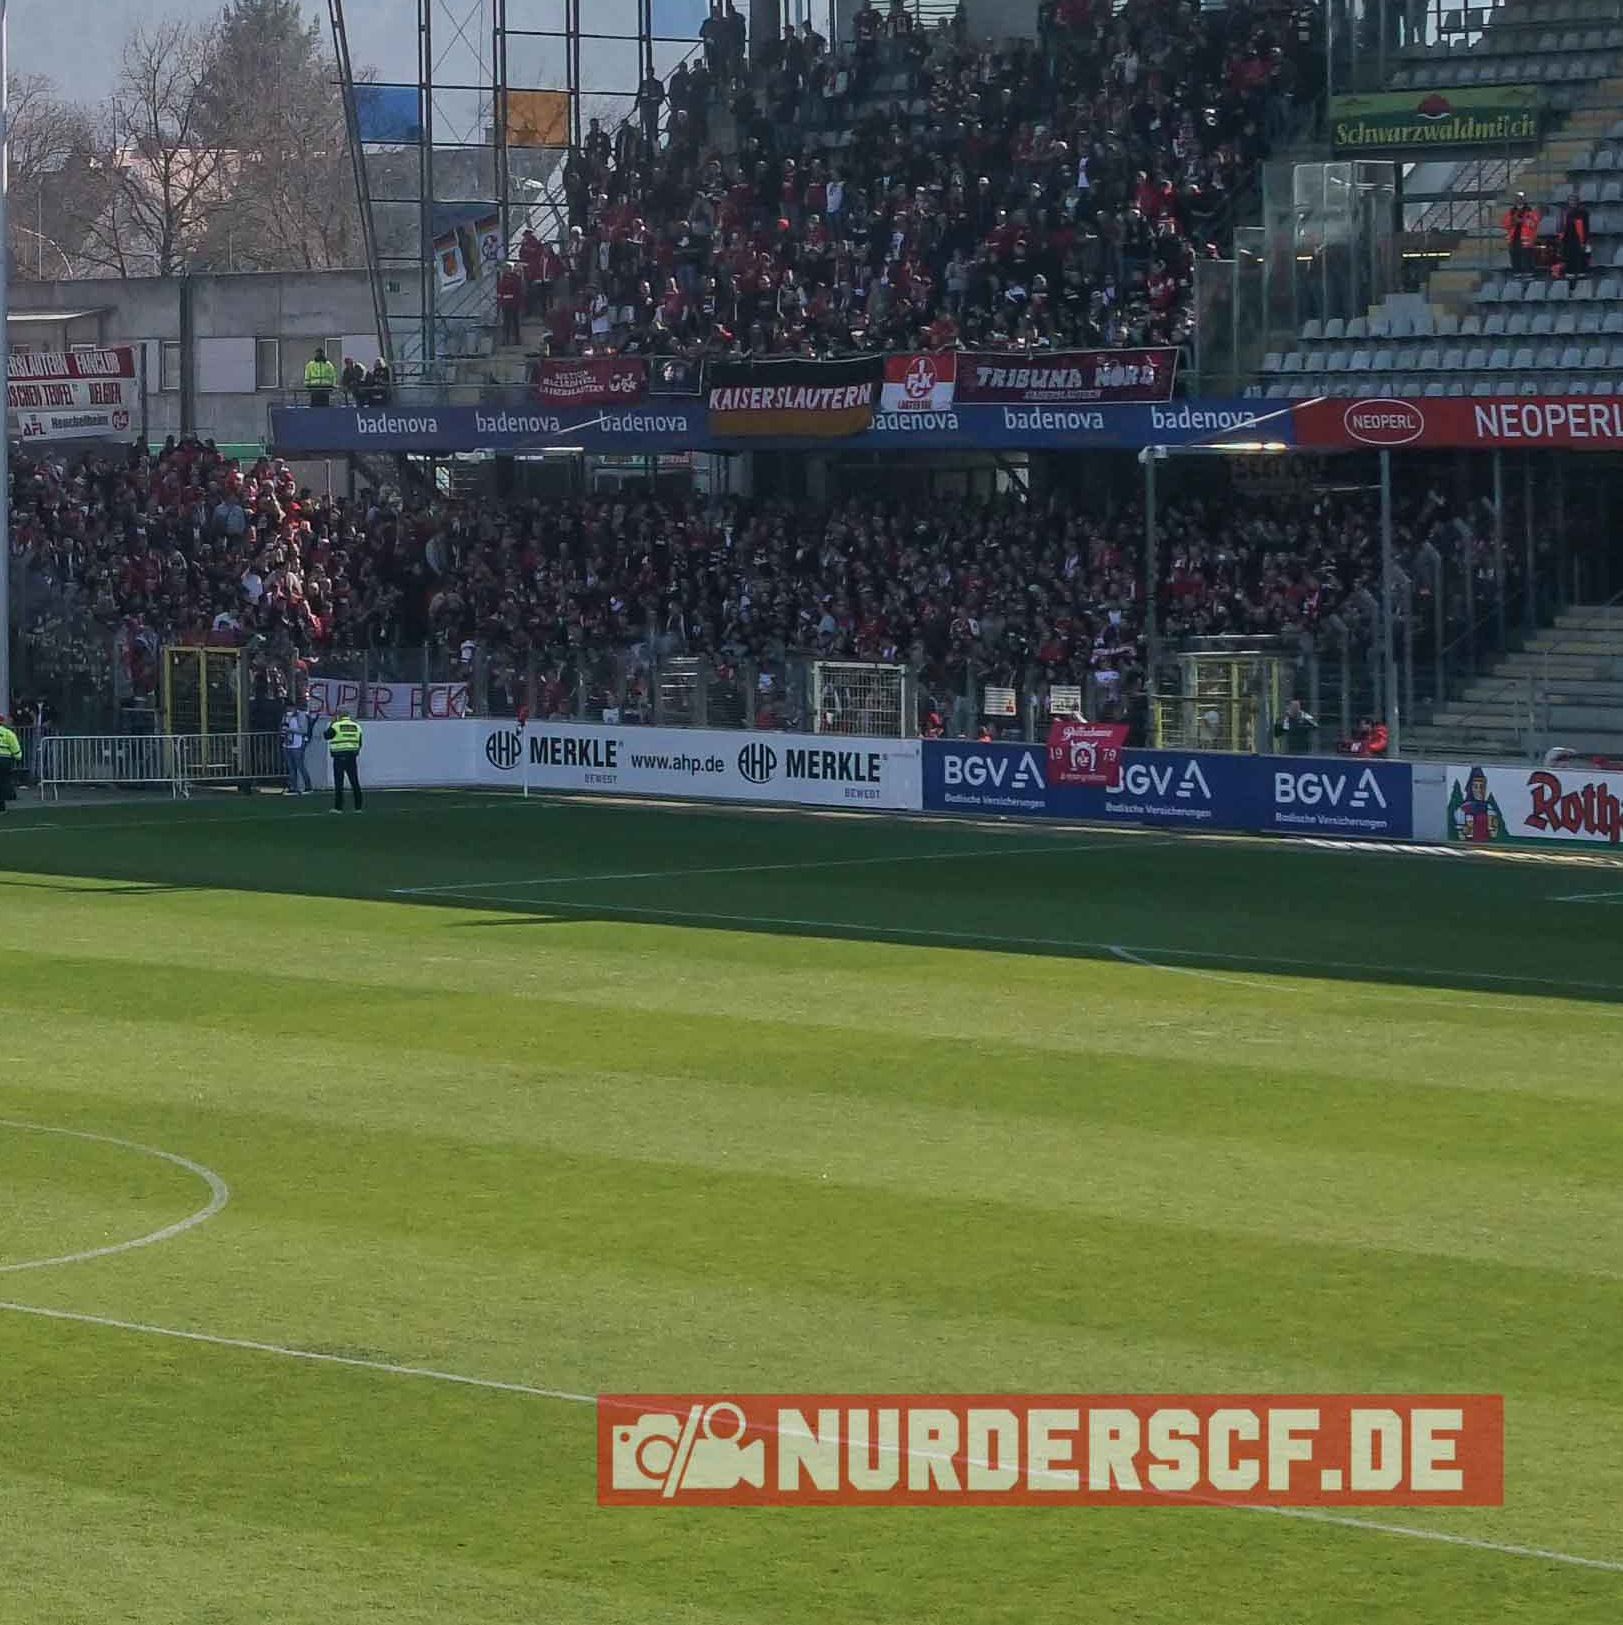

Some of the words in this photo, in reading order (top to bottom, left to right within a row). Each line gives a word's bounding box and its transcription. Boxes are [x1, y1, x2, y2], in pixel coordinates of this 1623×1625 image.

[709, 383, 873, 410] KAISERSLAUTERN
[357, 410, 438, 434] badenova
[475, 411, 561, 433] badenova
[600, 409, 688, 432] badenova
[1004, 406, 1104, 430] badenova
[1152, 404, 1256, 430] badenova
[1352, 414, 1416, 430] NEOPERL
[1474, 403, 1623, 438] NEOPERL
[529, 736, 618, 768] MERKLE
[631, 753, 725, 777] www.ahp.de
[785, 748, 881, 783] MERKLE
[944, 755, 1008, 789] BGV
[983, 794, 1046, 809] Versicherungen
[1275, 772, 1346, 807] BGV
[1146, 804, 1212, 819] Versicherungen
[1524, 770, 1623, 846] Roth
[1319, 814, 1387, 830] Versicherungen
